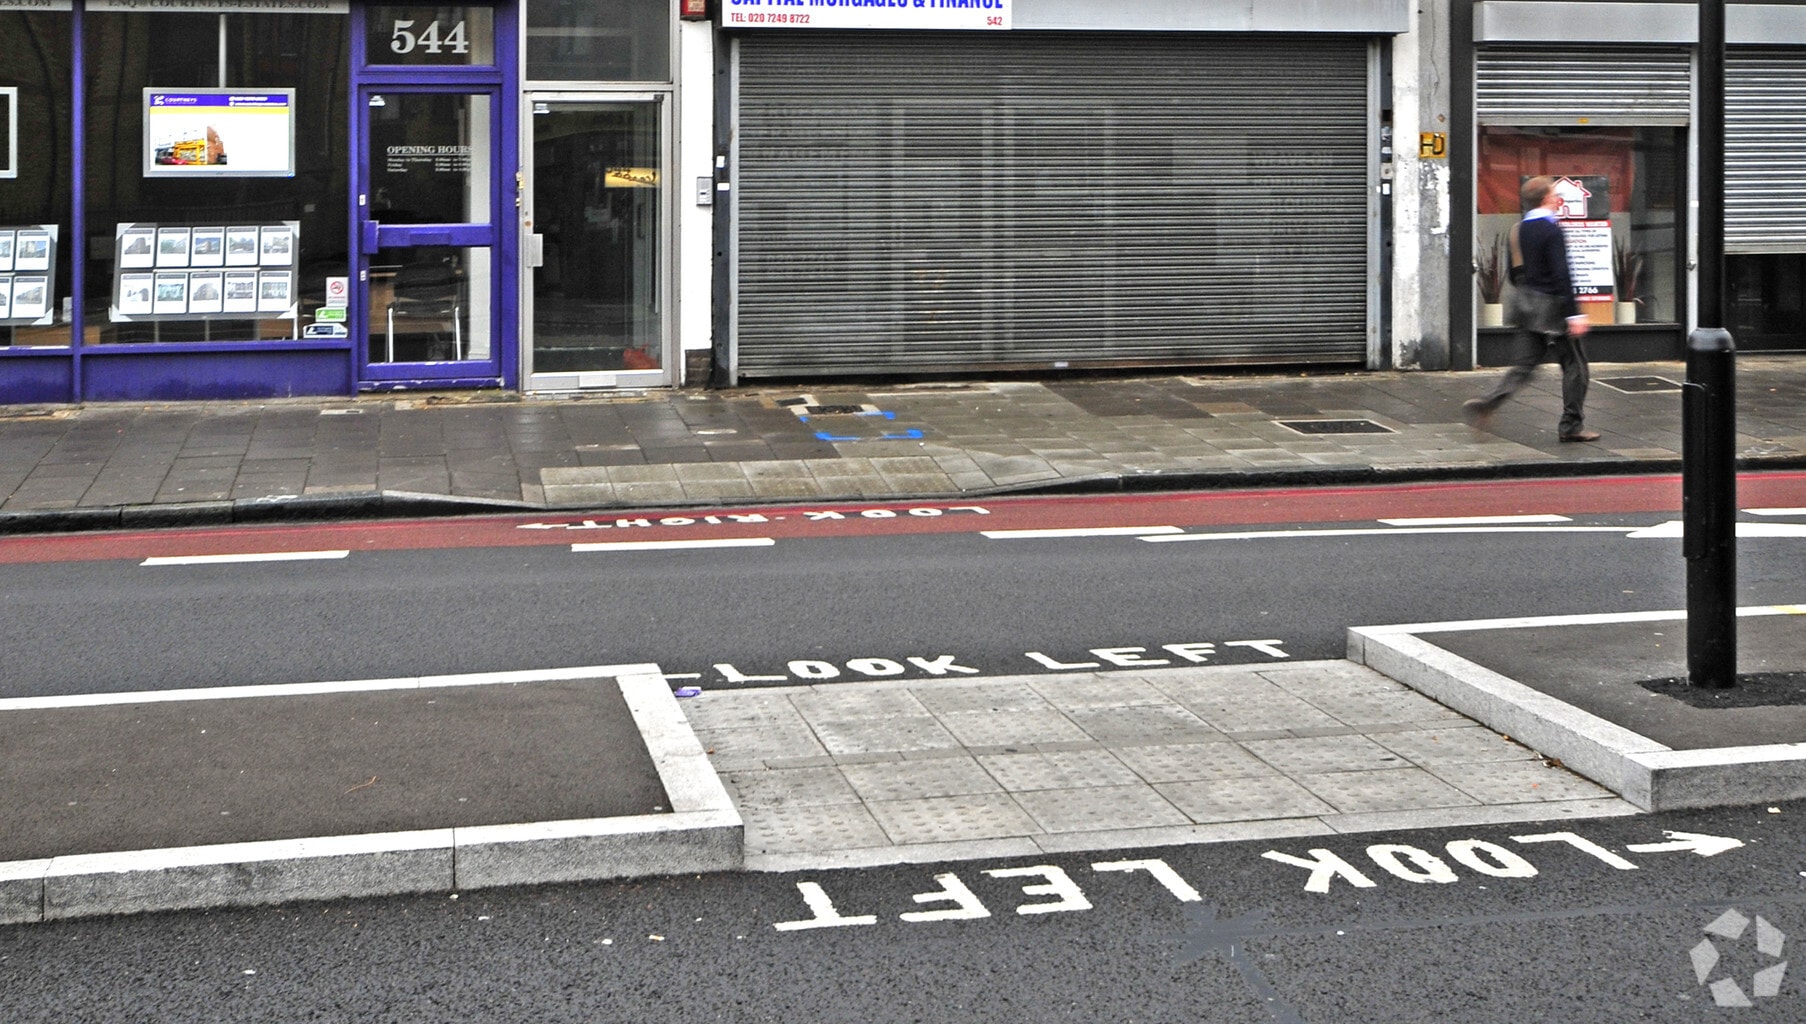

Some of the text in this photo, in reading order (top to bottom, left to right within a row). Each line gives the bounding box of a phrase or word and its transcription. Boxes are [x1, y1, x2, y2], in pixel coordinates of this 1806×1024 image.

[730, 13, 811, 24] TEL: 020 7249 8722
[986, 16, 1003, 26] 542
[390, 19, 469, 54] 544
[386, 145, 436, 154] OPENING
[803, 506, 991, 521] LOOK
[712, 639, 1292, 683] LOOK LEFT
[774, 831, 1640, 933] LOOK LEFT
